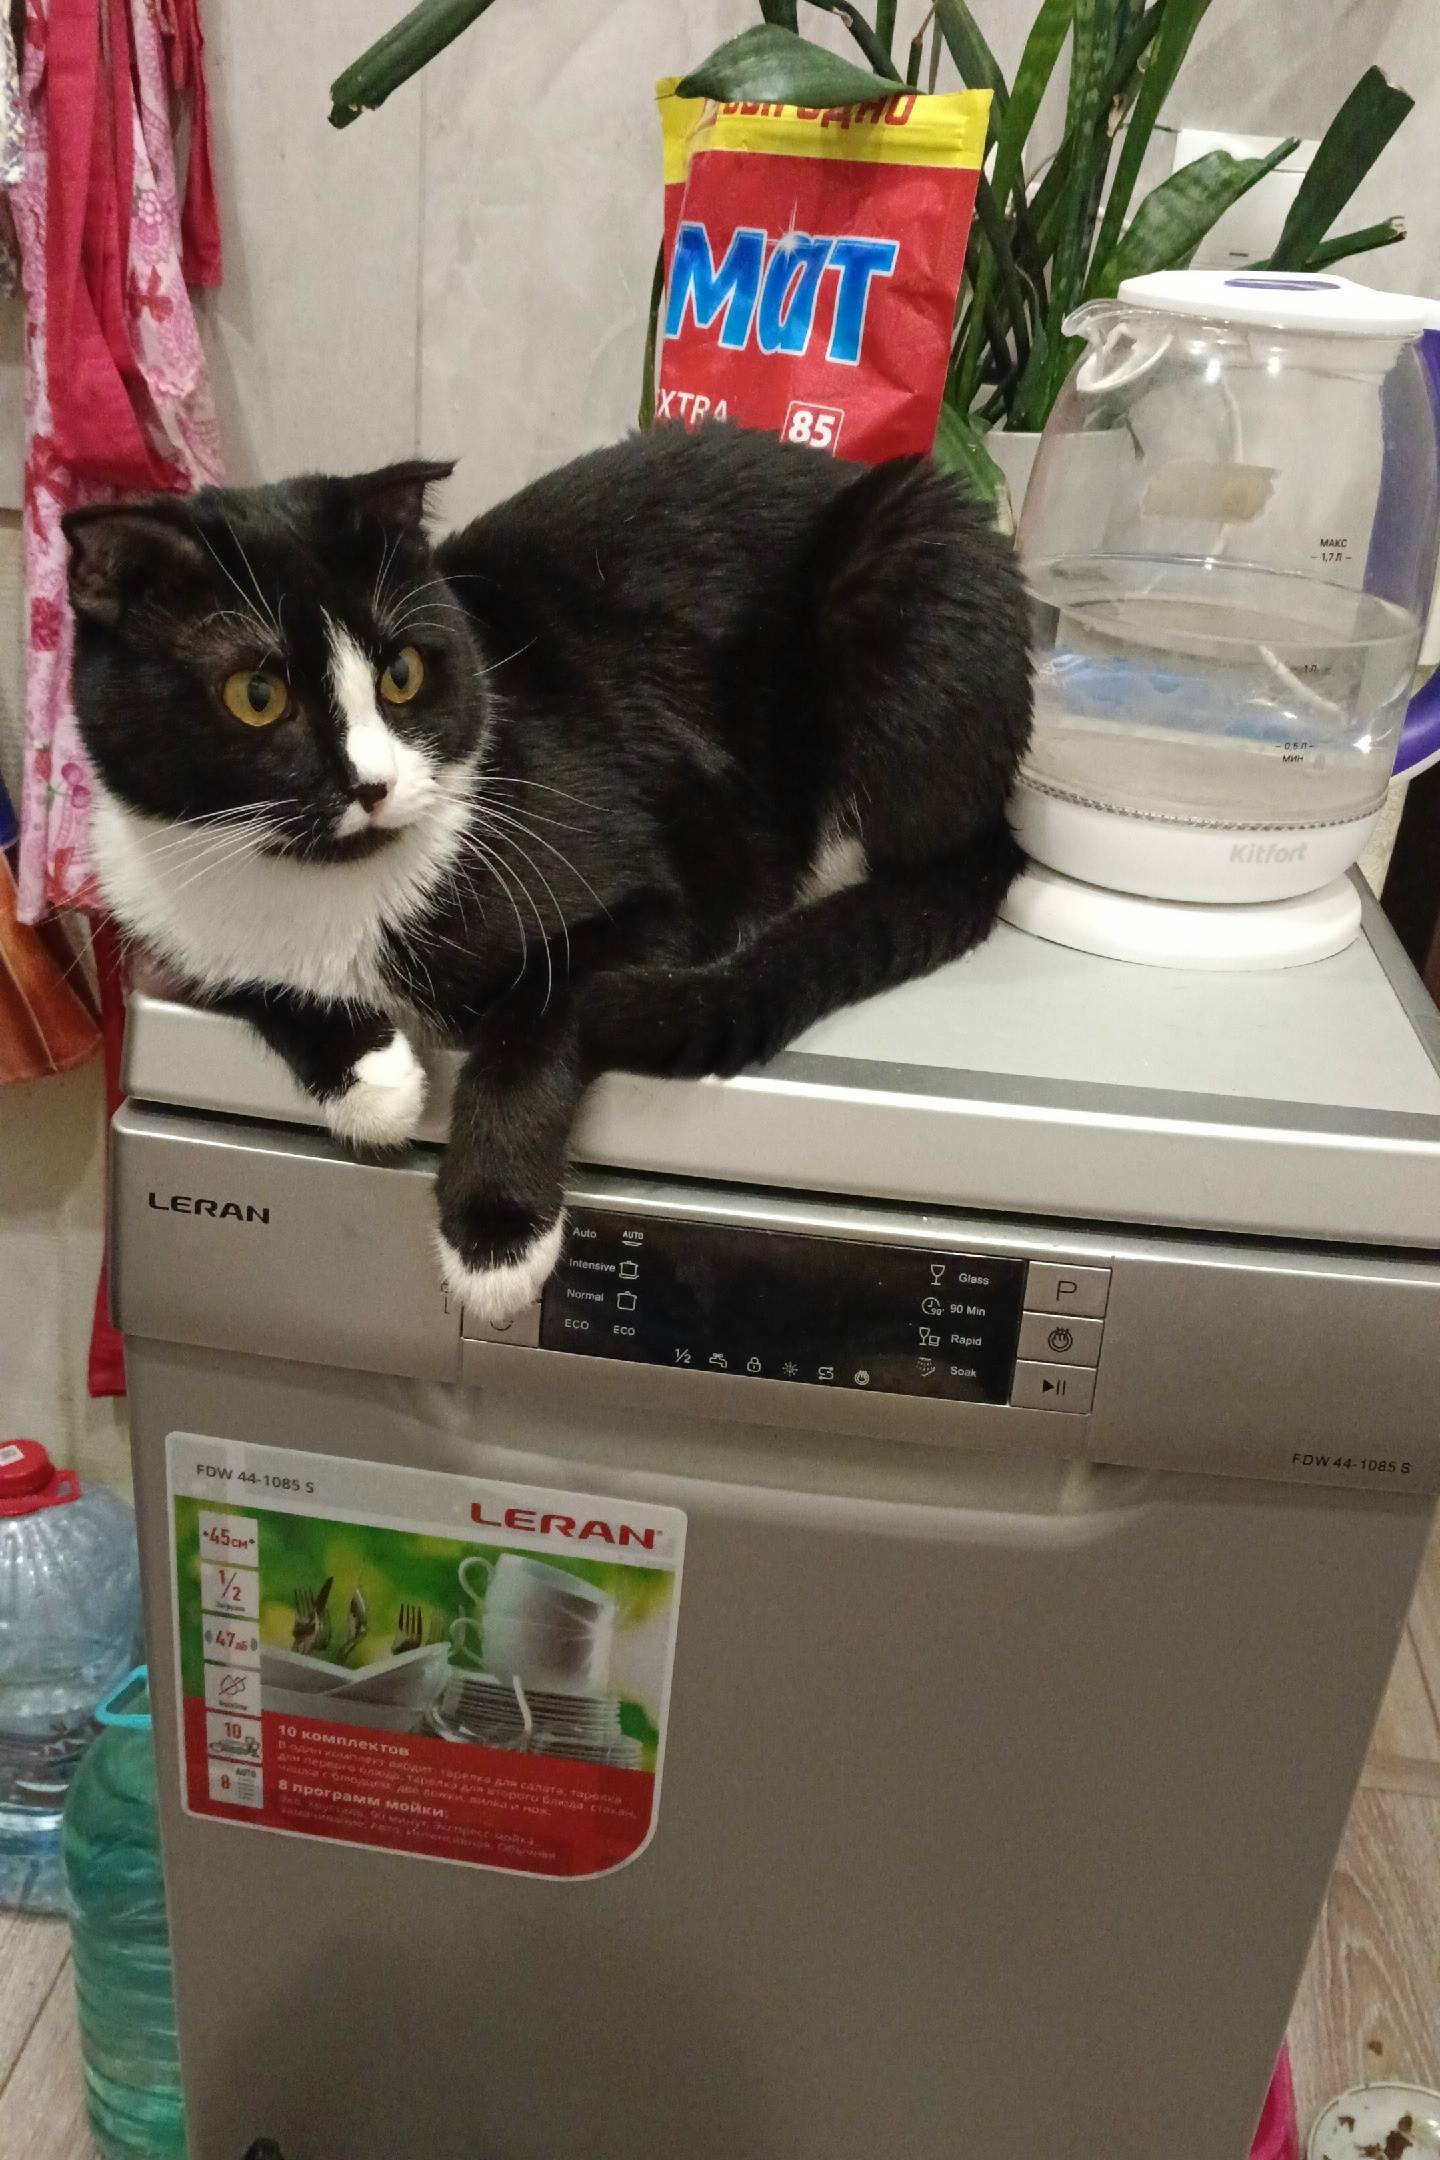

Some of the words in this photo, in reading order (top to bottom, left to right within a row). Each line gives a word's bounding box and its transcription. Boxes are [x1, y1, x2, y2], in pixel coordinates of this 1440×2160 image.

[656, 388, 728, 424] XTRA
[788, 410, 836, 448] 85
[1320, 538, 1347, 548] МАКС
[1282, 754, 1304, 763] МИН
[1229, 842, 1307, 864] Kitfort
[149, 1192, 270, 1224] LERAN
[572, 1226, 598, 1239] Auto
[622, 1230, 645, 1240] AUTO
[569, 1258, 617, 1273] Intensive
[958, 1272, 990, 1286] Glass
[567, 1288, 605, 1302] Normal
[950, 1304, 964, 1315] 90
[966, 1305, 986, 1316] Min
[564, 1318, 590, 1330] ECO
[613, 1325, 636, 1336] ECO
[950, 1334, 982, 1347] Rapid
[950, 1366, 977, 1378] Soak
[1293, 1453, 1330, 1467] FDW
[1332, 1456, 1397, 1473] 44-1085
[1401, 1462, 1412, 1474] S
[196, 1464, 233, 1480] FDW
[237, 1471, 301, 1492] 44-1085
[305, 1481, 315, 1494] S
[470, 1502, 656, 1549] LERAN
[224, 1721, 242, 1739] 10
[277, 1723, 296, 1737] 10
[301, 1729, 410, 1757] комплектов
[220, 1774, 230, 1790] 8
[278, 1778, 287, 1791] 8
[292, 1783, 380, 1807] программ
